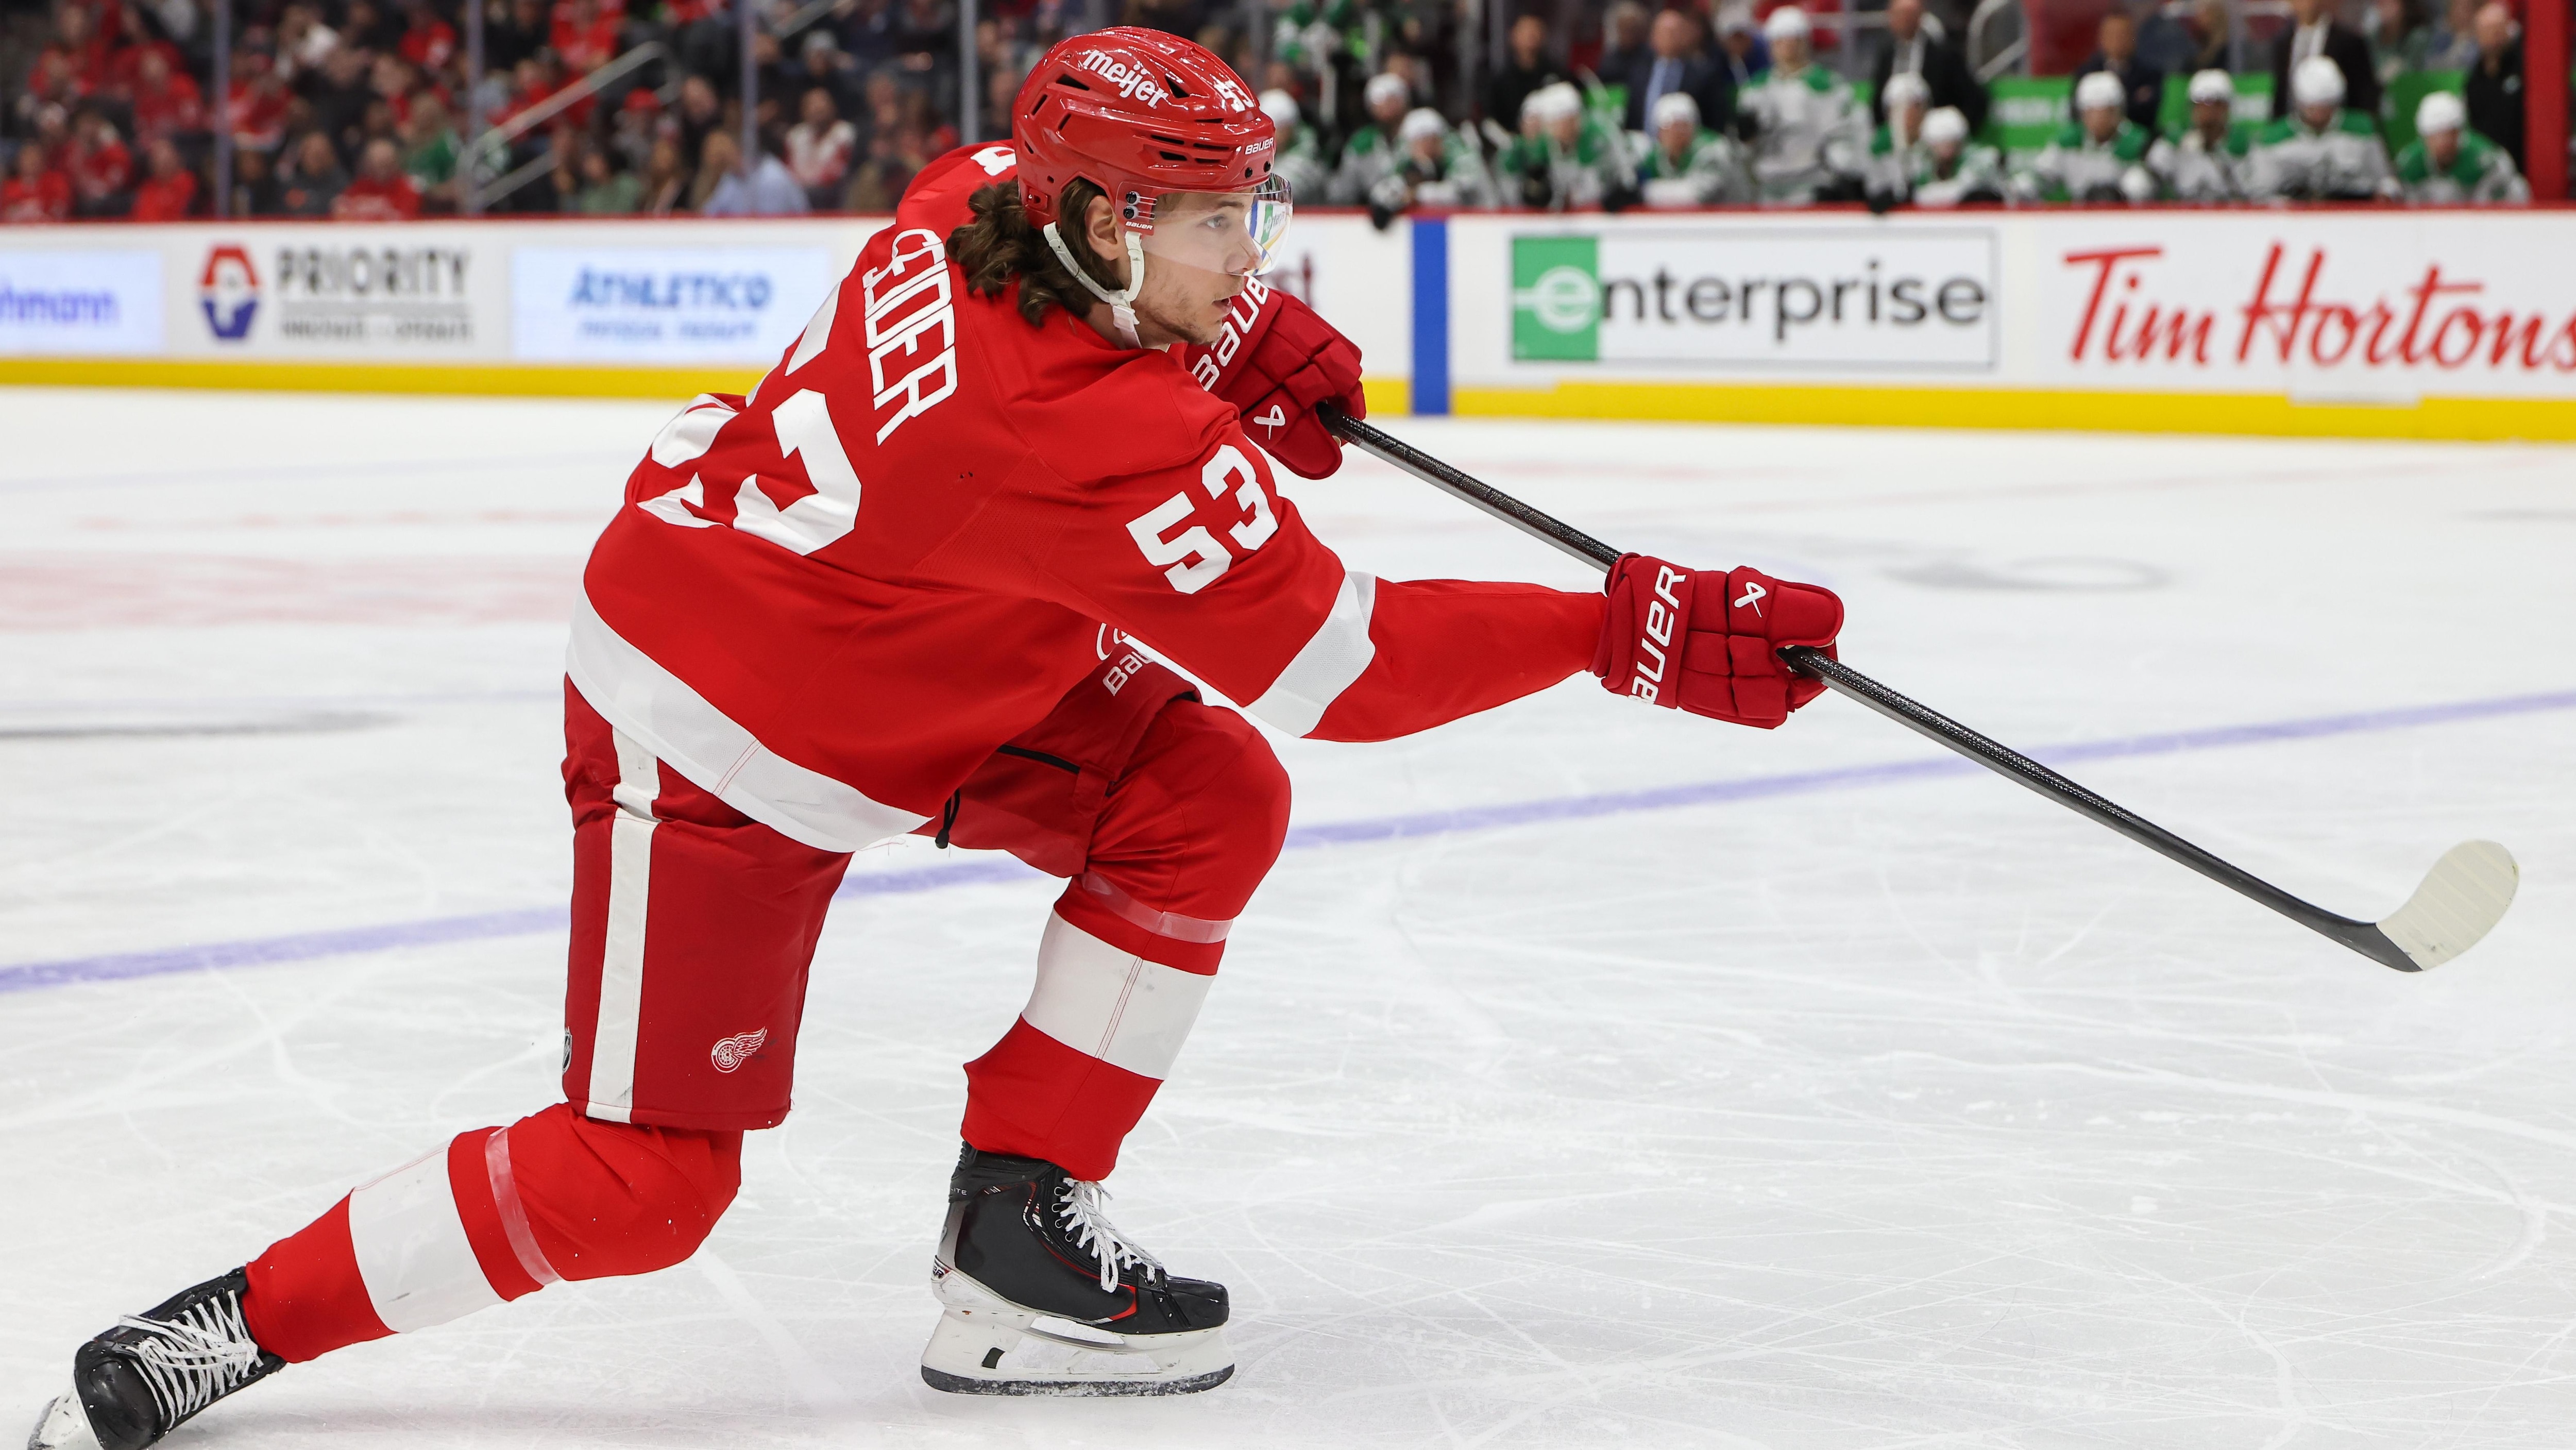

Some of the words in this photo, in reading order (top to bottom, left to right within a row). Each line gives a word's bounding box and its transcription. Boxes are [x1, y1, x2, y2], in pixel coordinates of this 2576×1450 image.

[1082, 49, 1169, 108] meijer
[1245, 137, 1274, 155] BAUER
[1125, 221, 1154, 230] BAUER
[277, 245, 474, 295] PRIORITY
[1513, 258, 1988, 344] enterprise
[2061, 244, 2216, 366] Tim
[2236, 238, 2576, 373] Hortons
[1126, 444, 1279, 595] 53
